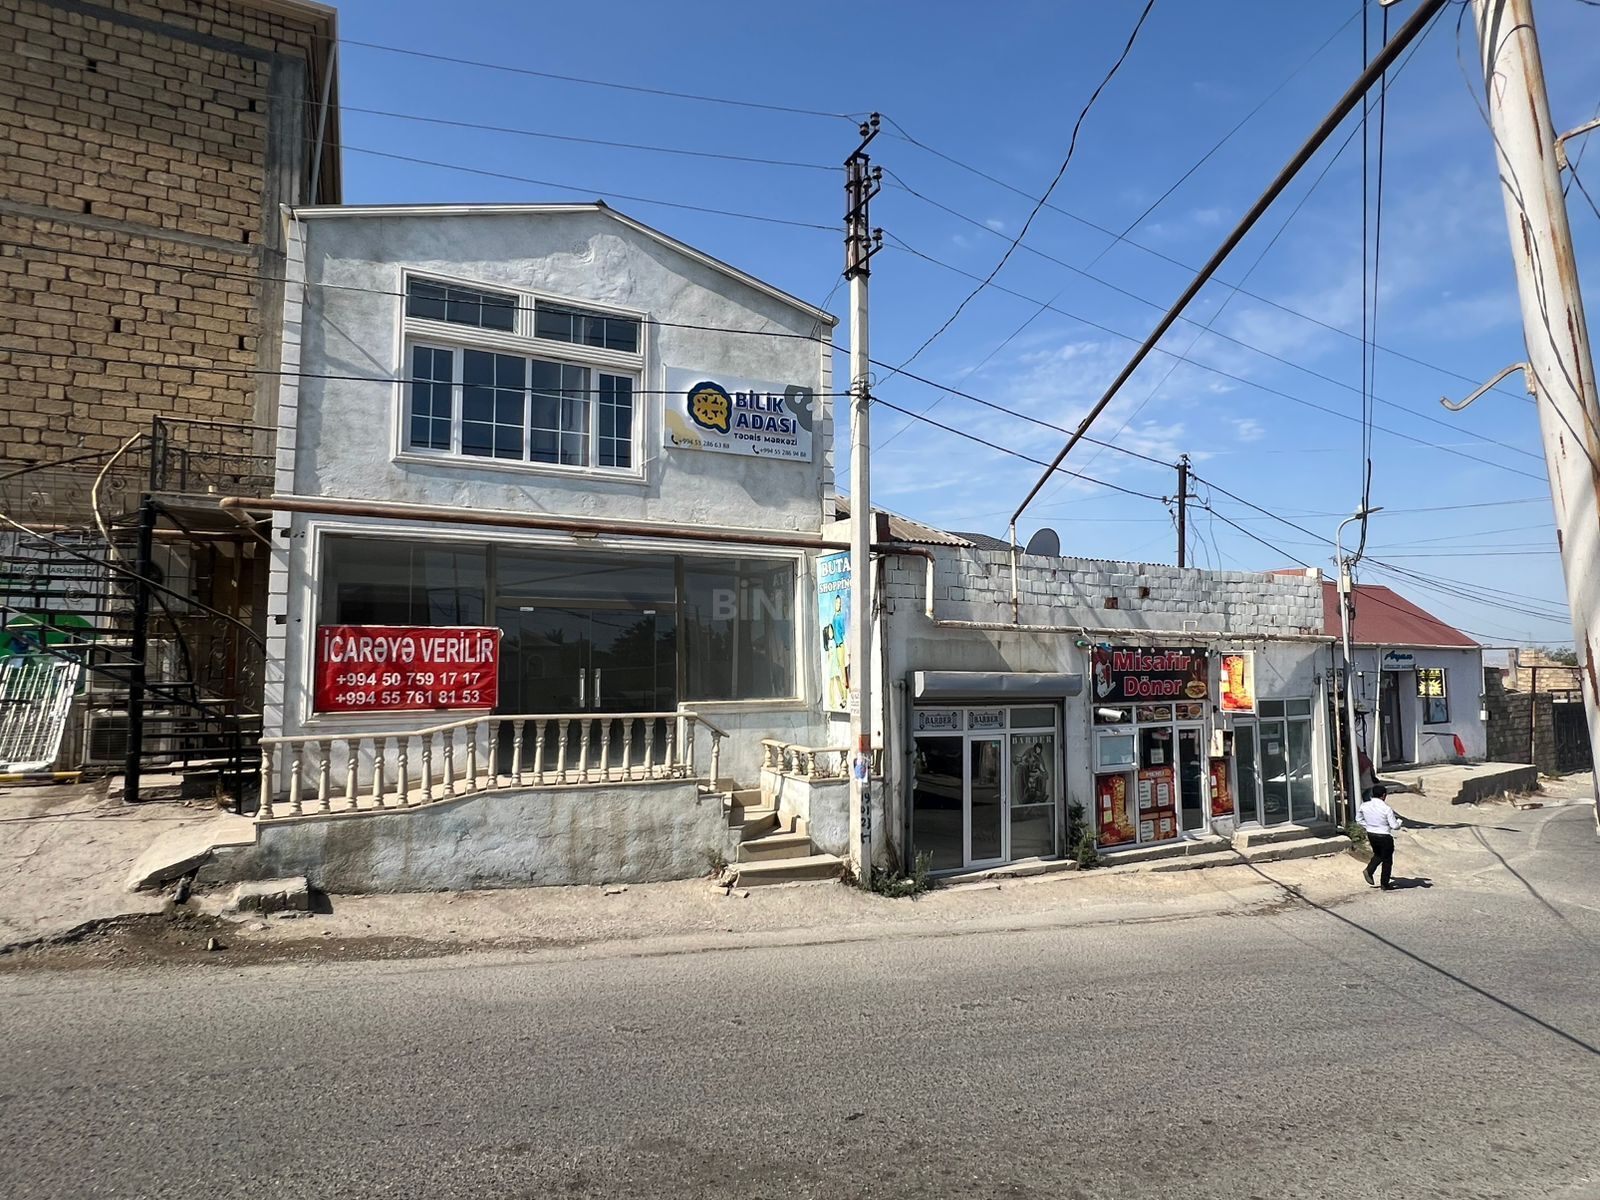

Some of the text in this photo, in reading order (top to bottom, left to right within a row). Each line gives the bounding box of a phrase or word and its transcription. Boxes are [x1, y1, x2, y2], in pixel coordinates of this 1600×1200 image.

[735, 389, 784, 414] BİLİK
[736, 412, 797, 435] ADASI
[821, 556, 851, 578] BUTA
[323, 629, 494, 663] İCARƏYƏ VERİLİR
[1112, 650, 1192, 672] Misafir
[336, 672, 480, 686] +994 50 759 17 17
[1123, 675, 1183, 697] Dönər
[335, 690, 480, 705] +994 55 761 81 53
[1012, 735, 1053, 745] BARBER
